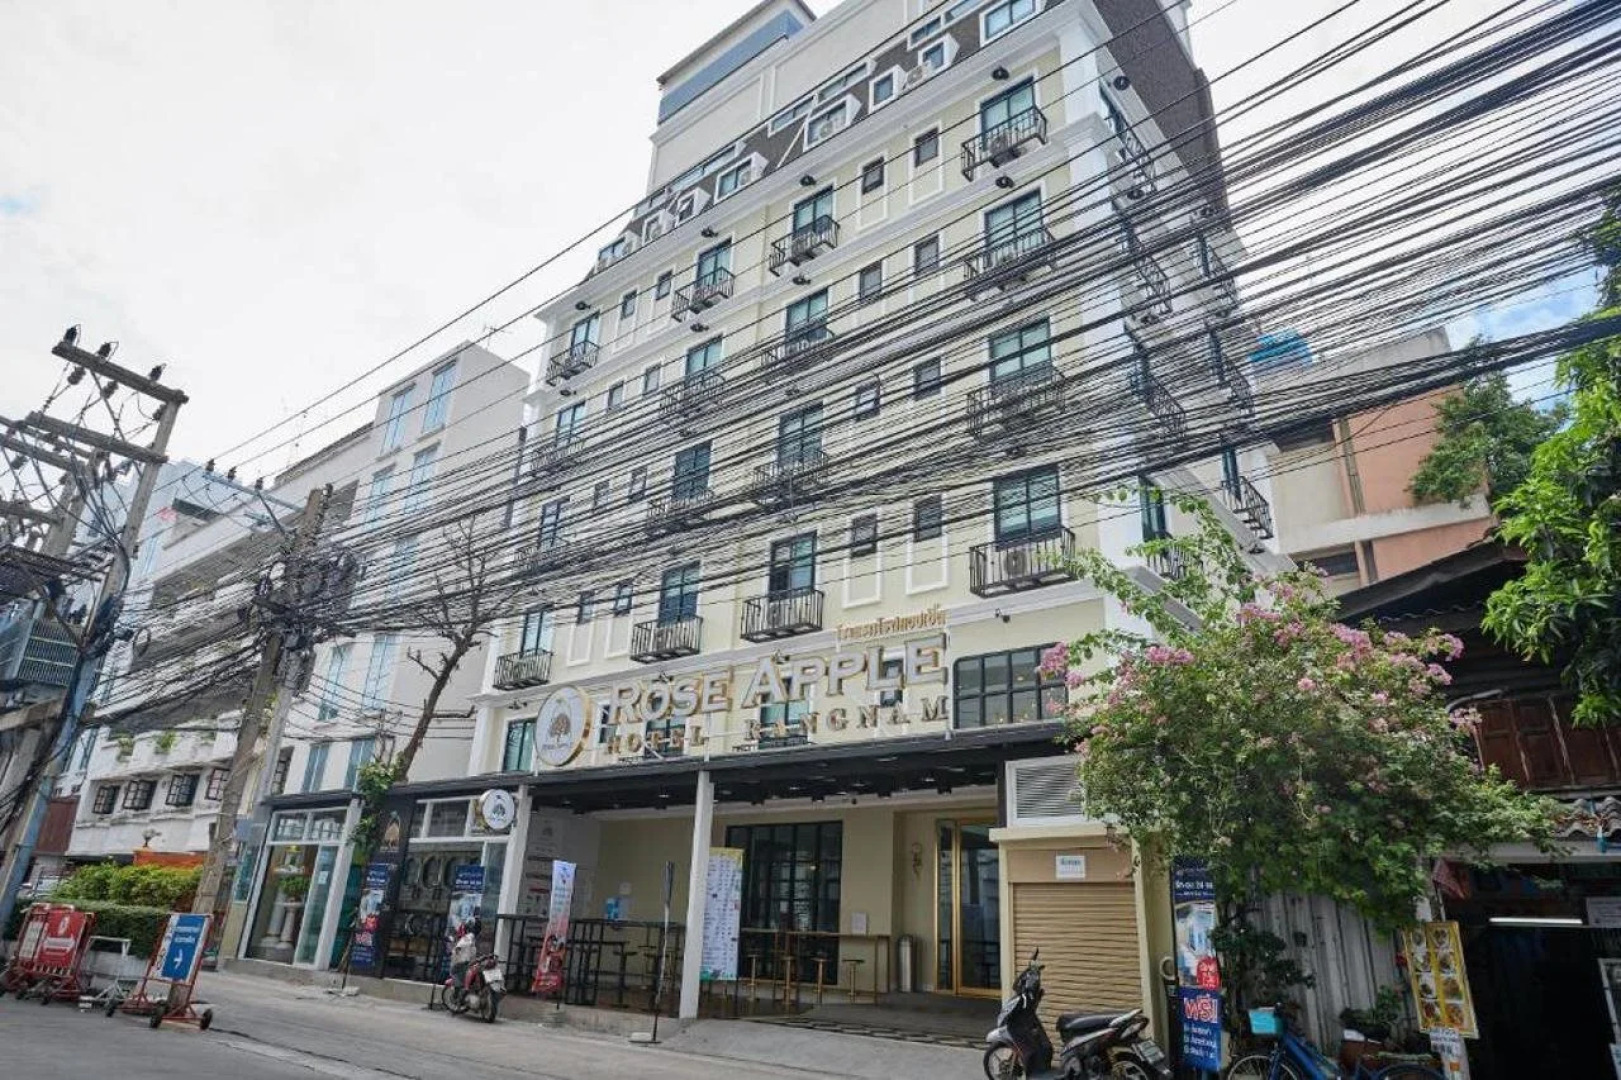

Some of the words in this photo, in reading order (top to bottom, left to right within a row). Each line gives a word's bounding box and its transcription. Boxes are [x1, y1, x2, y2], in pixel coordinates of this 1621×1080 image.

[608, 665, 733, 725] ROSE
[741, 633, 949, 709] APPLE
[607, 725, 709, 754] HOTEL
